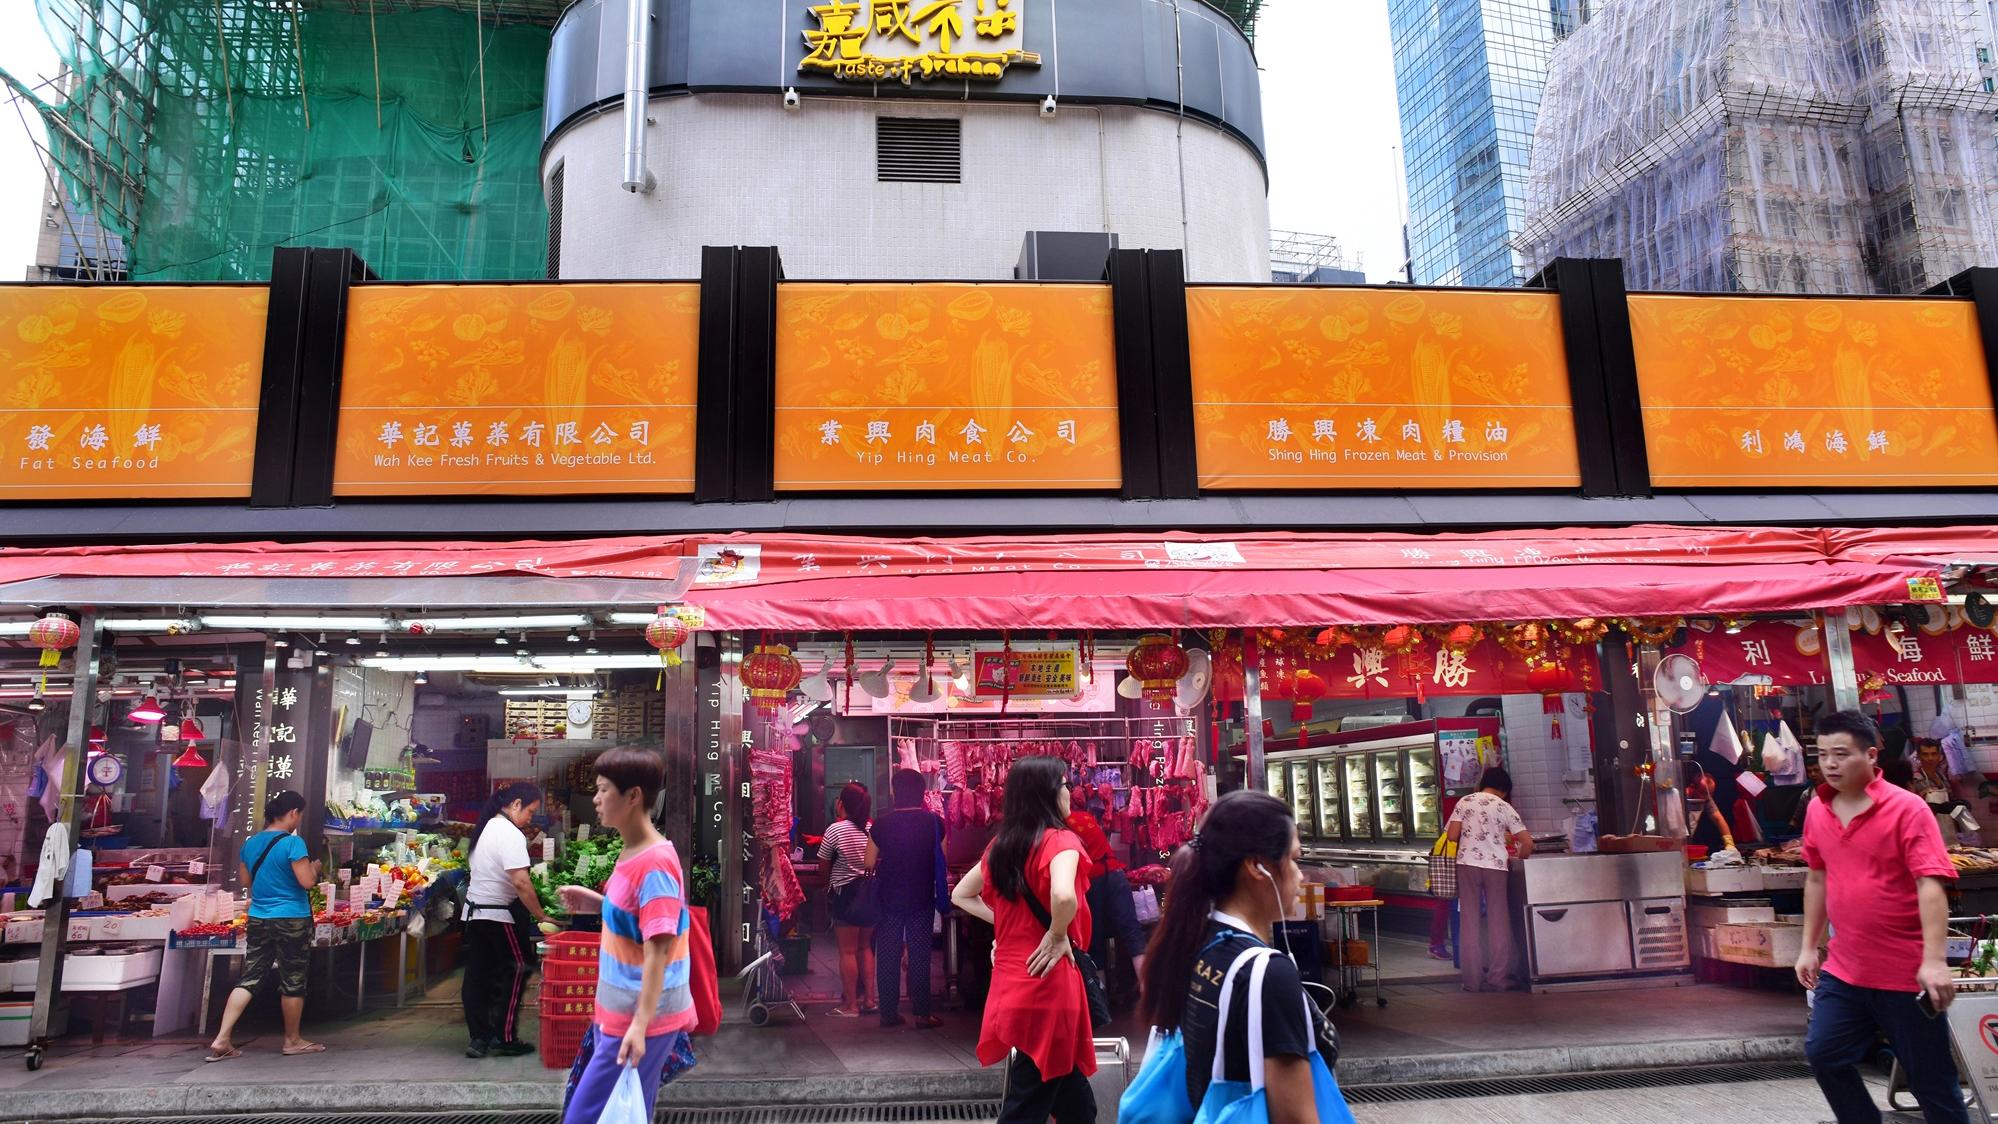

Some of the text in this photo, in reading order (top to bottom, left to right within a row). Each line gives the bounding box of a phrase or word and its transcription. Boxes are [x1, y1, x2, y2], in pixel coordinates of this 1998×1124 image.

[835, 60, 885, 77] Taste
[24, 423, 162, 451] 發海鮮
[378, 420, 651, 449] 華記菓菜有限公司
[818, 418, 1077, 445] 業興肉食公司
[1266, 417, 1508, 444] 勝興凍肉糧油
[1741, 429, 1889, 454] 利鴻海鮮
[20, 456, 159, 469] Fat Seafood
[374, 451, 656, 467] Wah Kee Fresh Fruits & Vegetable Ltd.
[856, 450, 1037, 466] Yip Hing Meat Co.
[1268, 448, 1508, 463] Shing Hing Frozen Meat & Provision
[1887, 667, 1947, 683] Seafood
[104, 920, 118, 929] 20
[71, 931, 82, 940] 60
